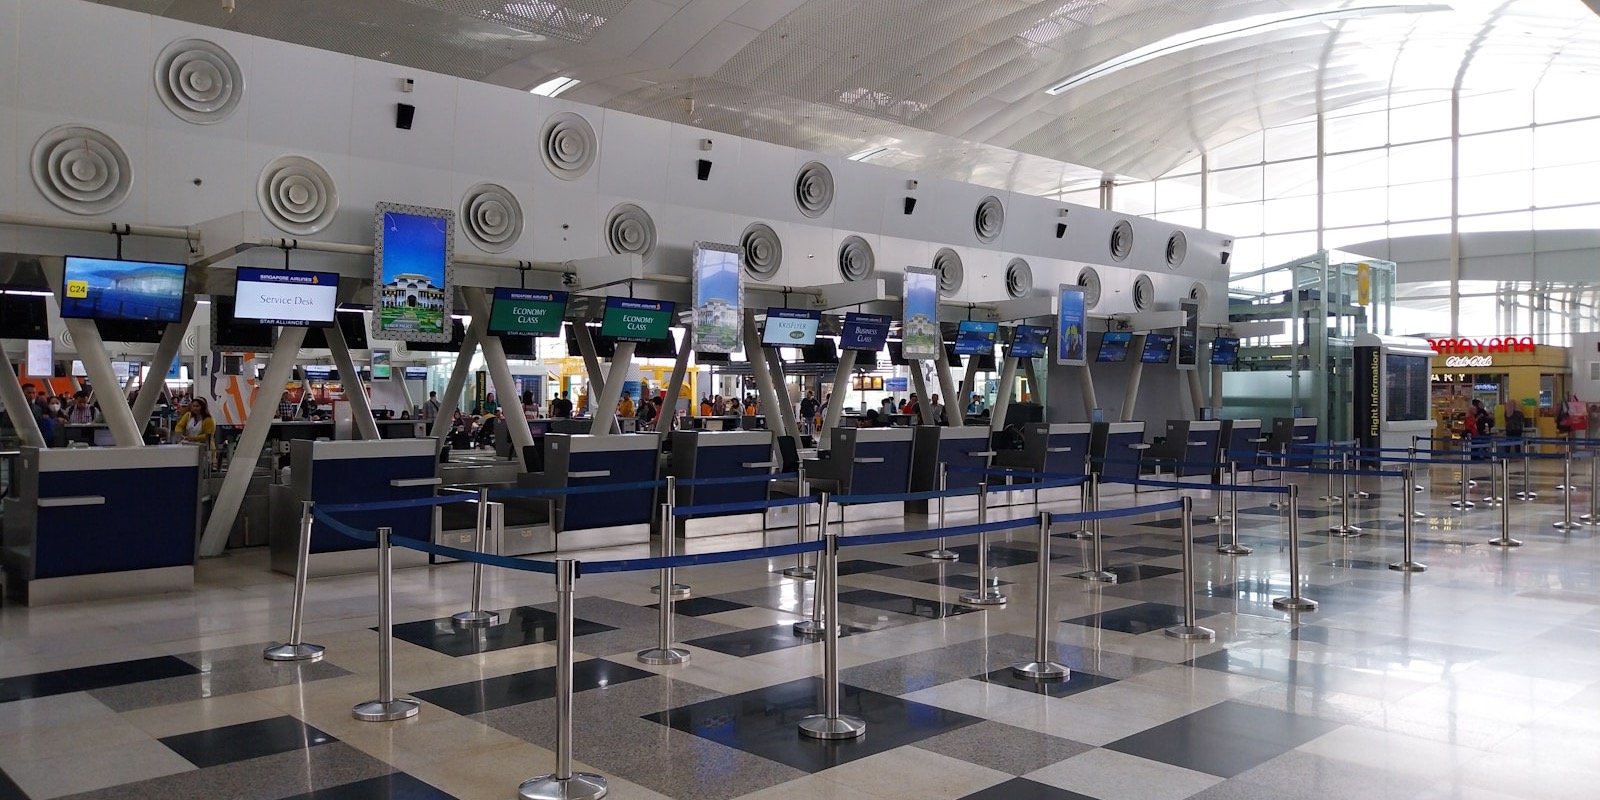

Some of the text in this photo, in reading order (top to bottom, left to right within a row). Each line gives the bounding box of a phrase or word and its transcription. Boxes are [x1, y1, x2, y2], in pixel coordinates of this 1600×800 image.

[69, 285, 85, 293] C24
[260, 294, 314, 306] Service Desk
[512, 306, 547, 316] ECONOMY
[517, 315, 539, 324] CLASS
[622, 314, 654, 324] ECONOMY
[627, 322, 647, 331] CLASS
[1371, 351, 1380, 437] Flight Information
